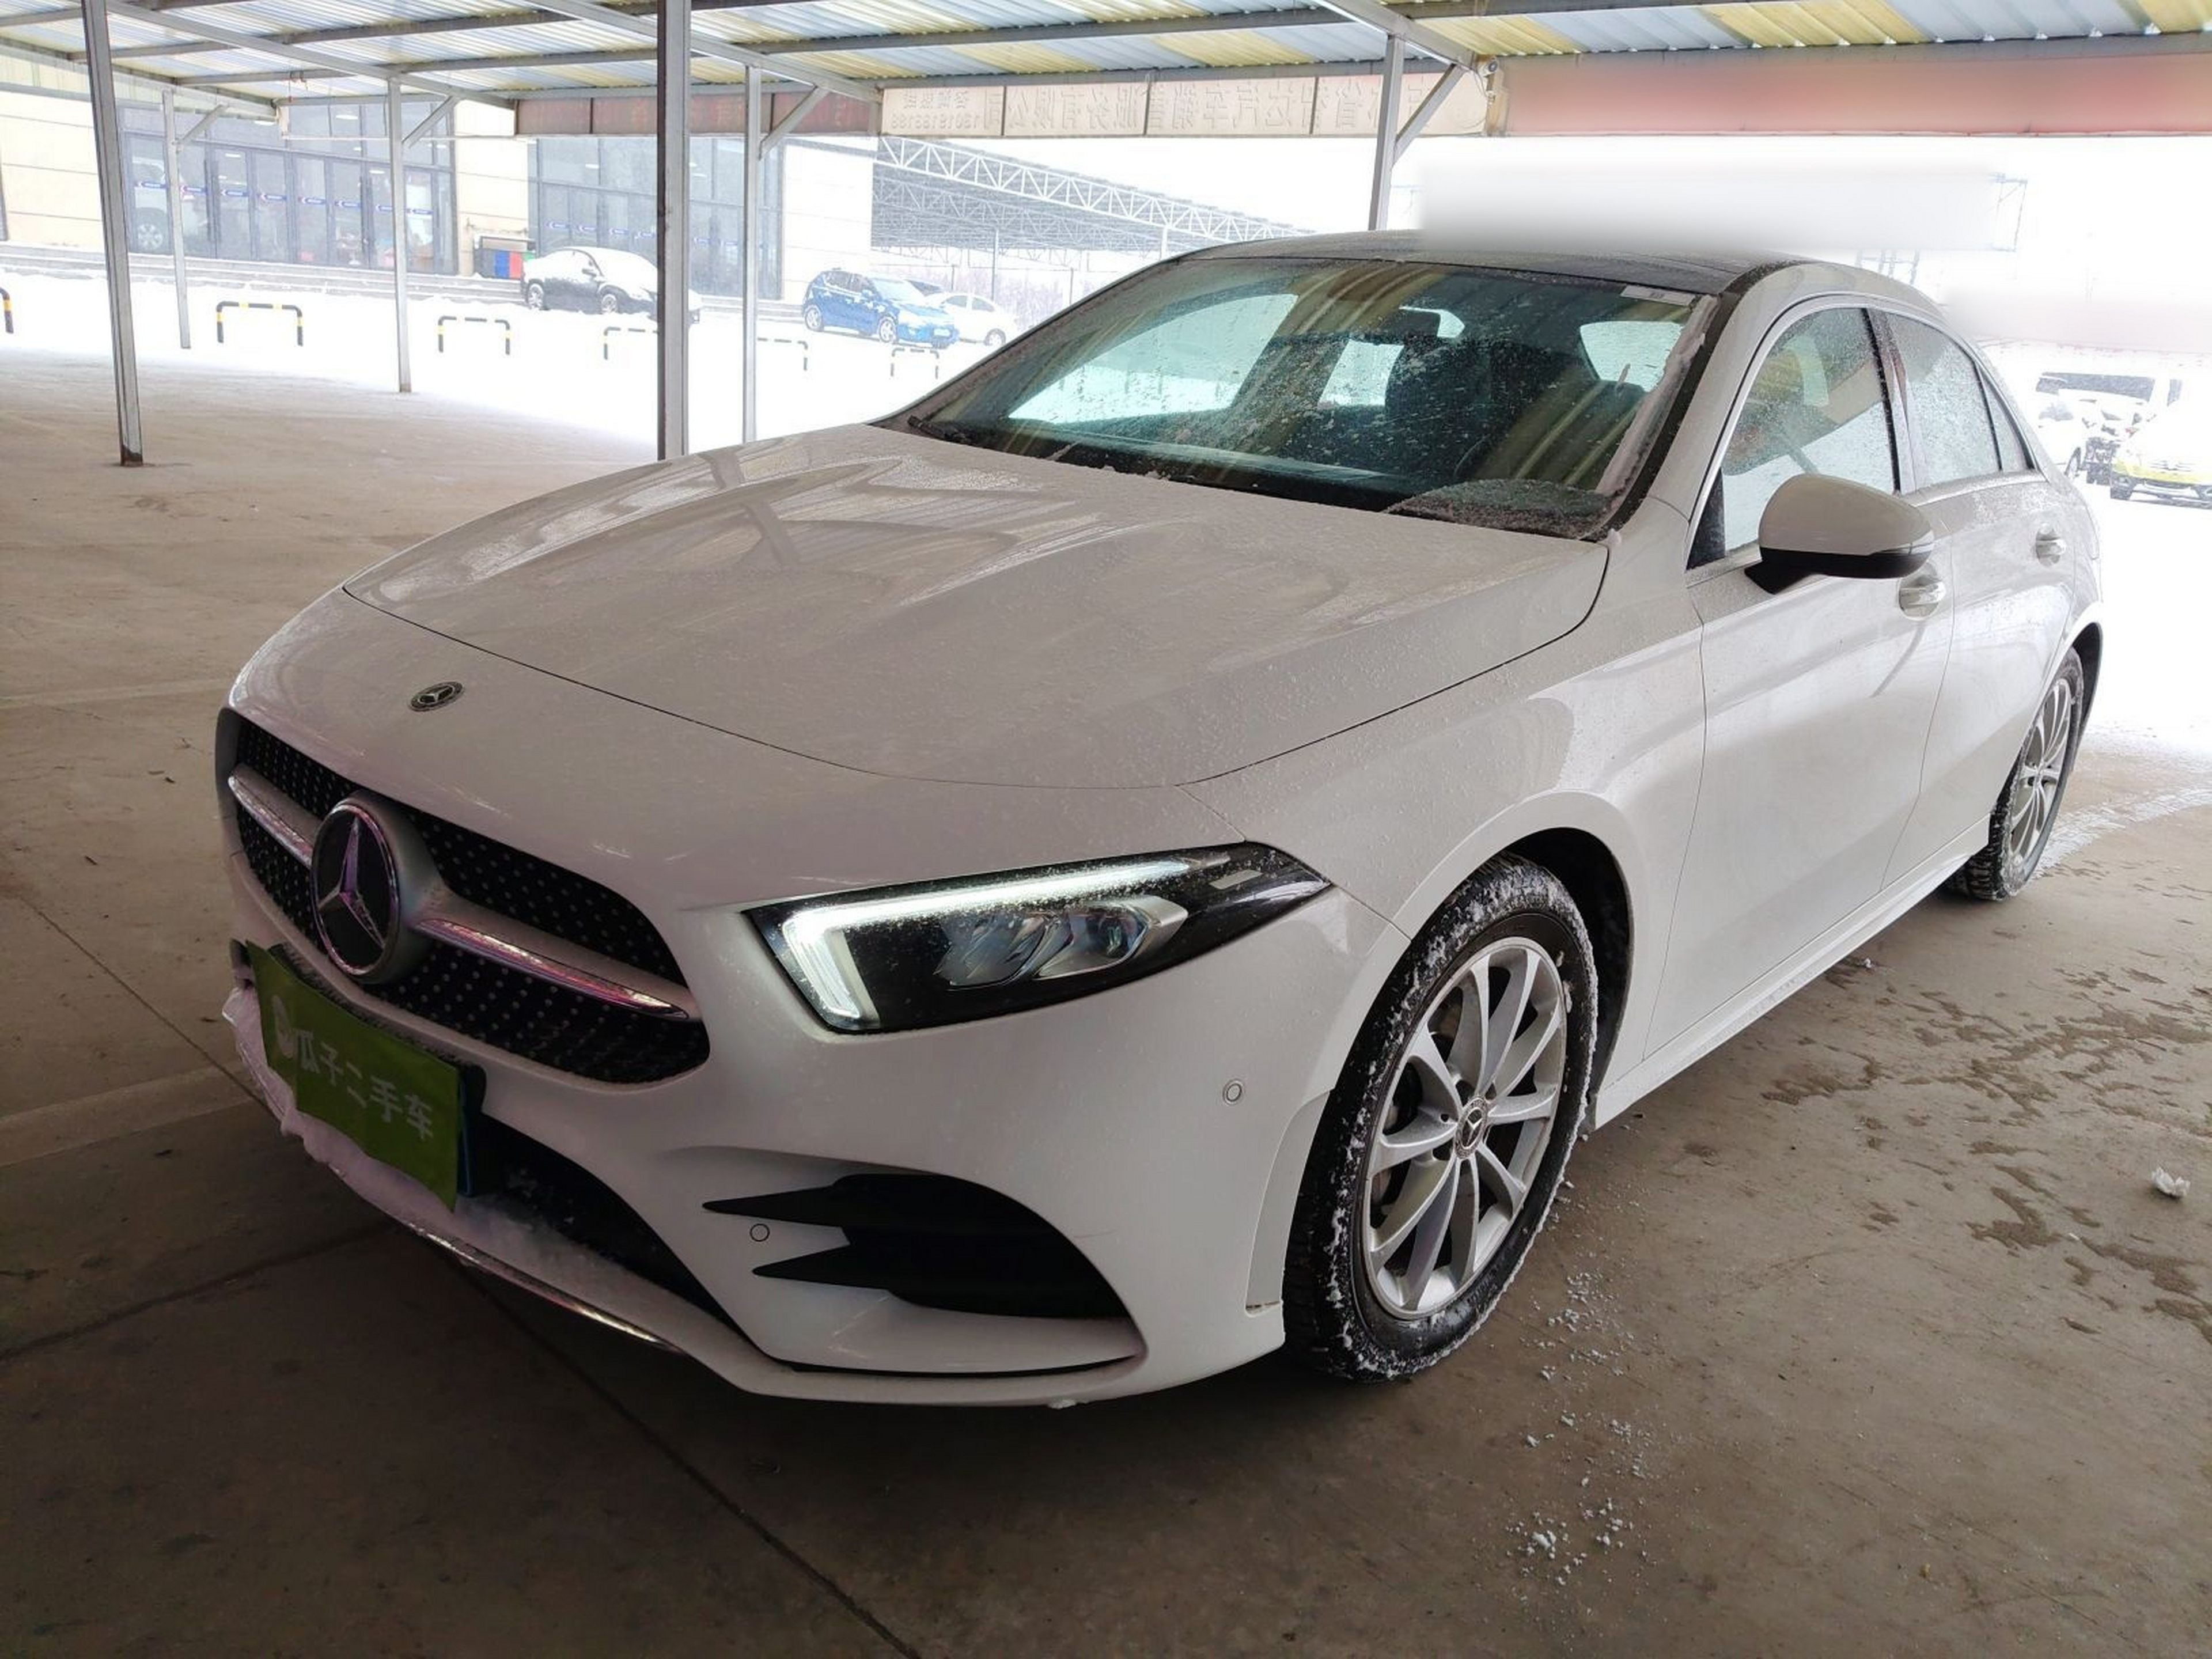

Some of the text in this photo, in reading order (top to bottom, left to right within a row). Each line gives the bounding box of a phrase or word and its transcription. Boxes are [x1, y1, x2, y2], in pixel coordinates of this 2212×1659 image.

[294, 1028, 433, 1140] 瓜子二手车
